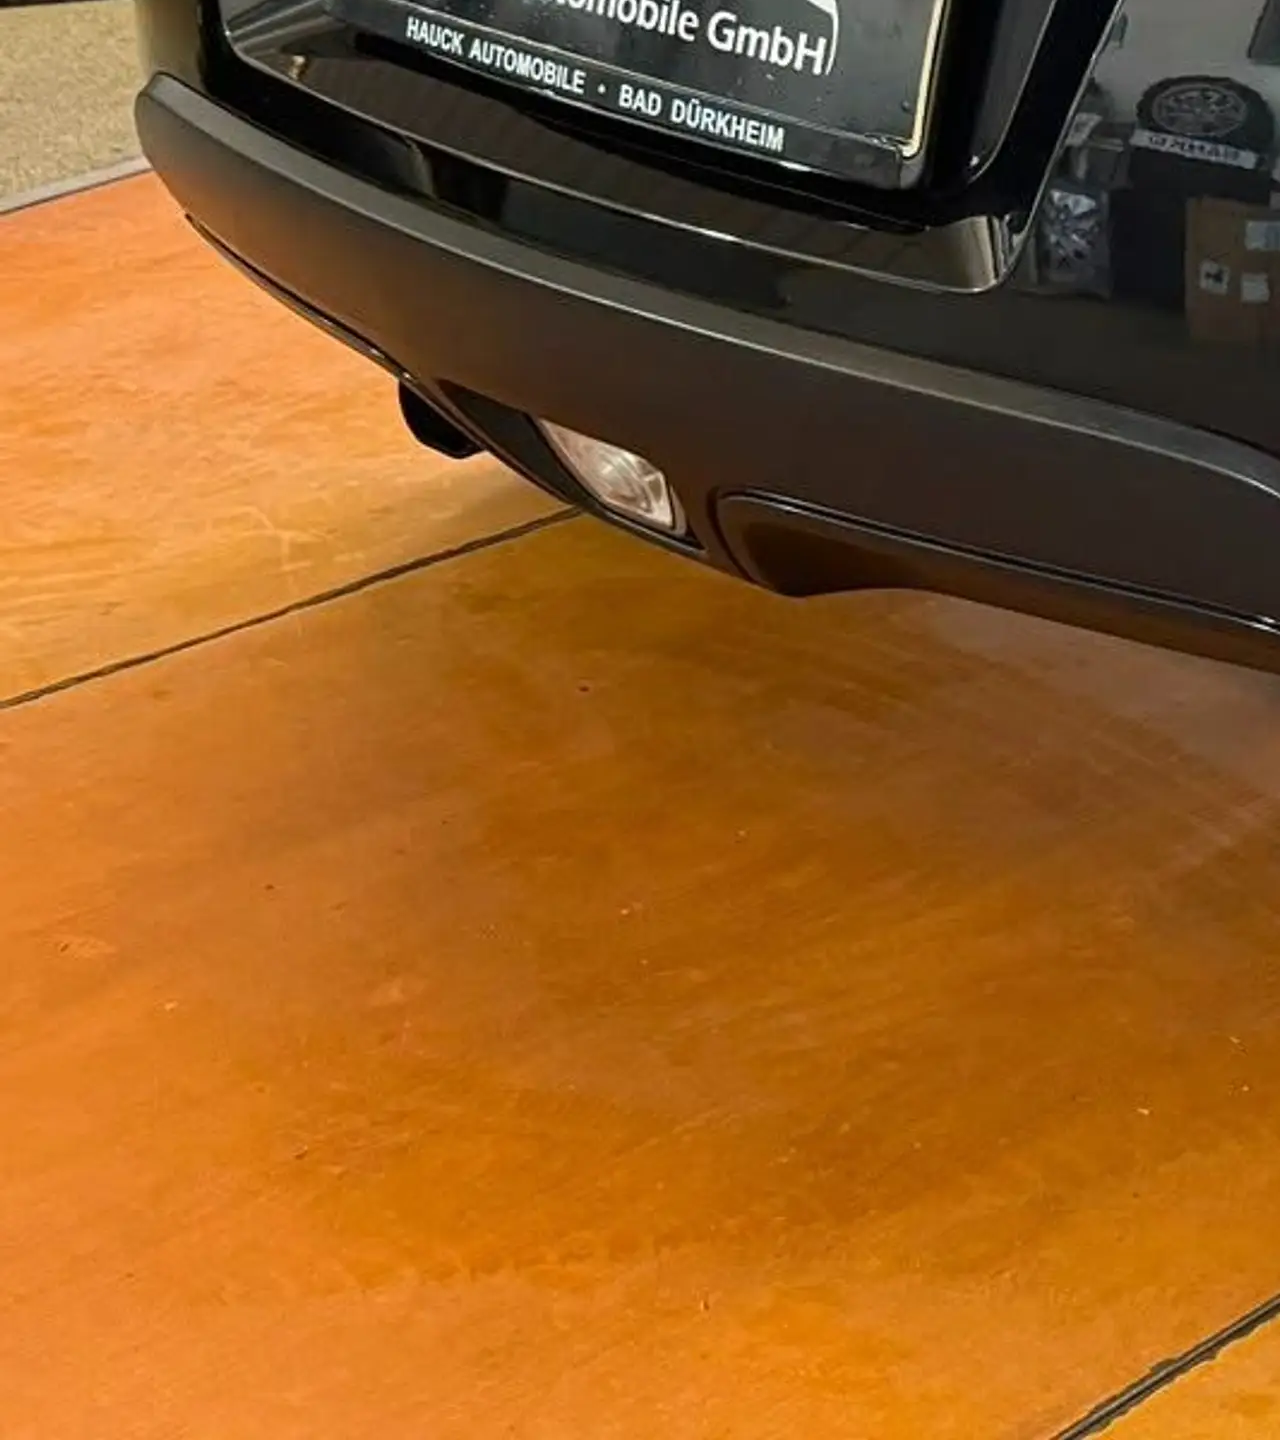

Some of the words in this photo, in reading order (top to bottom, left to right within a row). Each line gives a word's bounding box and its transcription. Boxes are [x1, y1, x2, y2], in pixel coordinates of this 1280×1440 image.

[407, 16, 464, 56] HAUCK
[470, 39, 586, 96] AUTOMOBILE
[619, 82, 662, 116] BAD
[671, 95, 784, 153] DÜRKHEIM
[707, 12, 827, 75] GmbH
